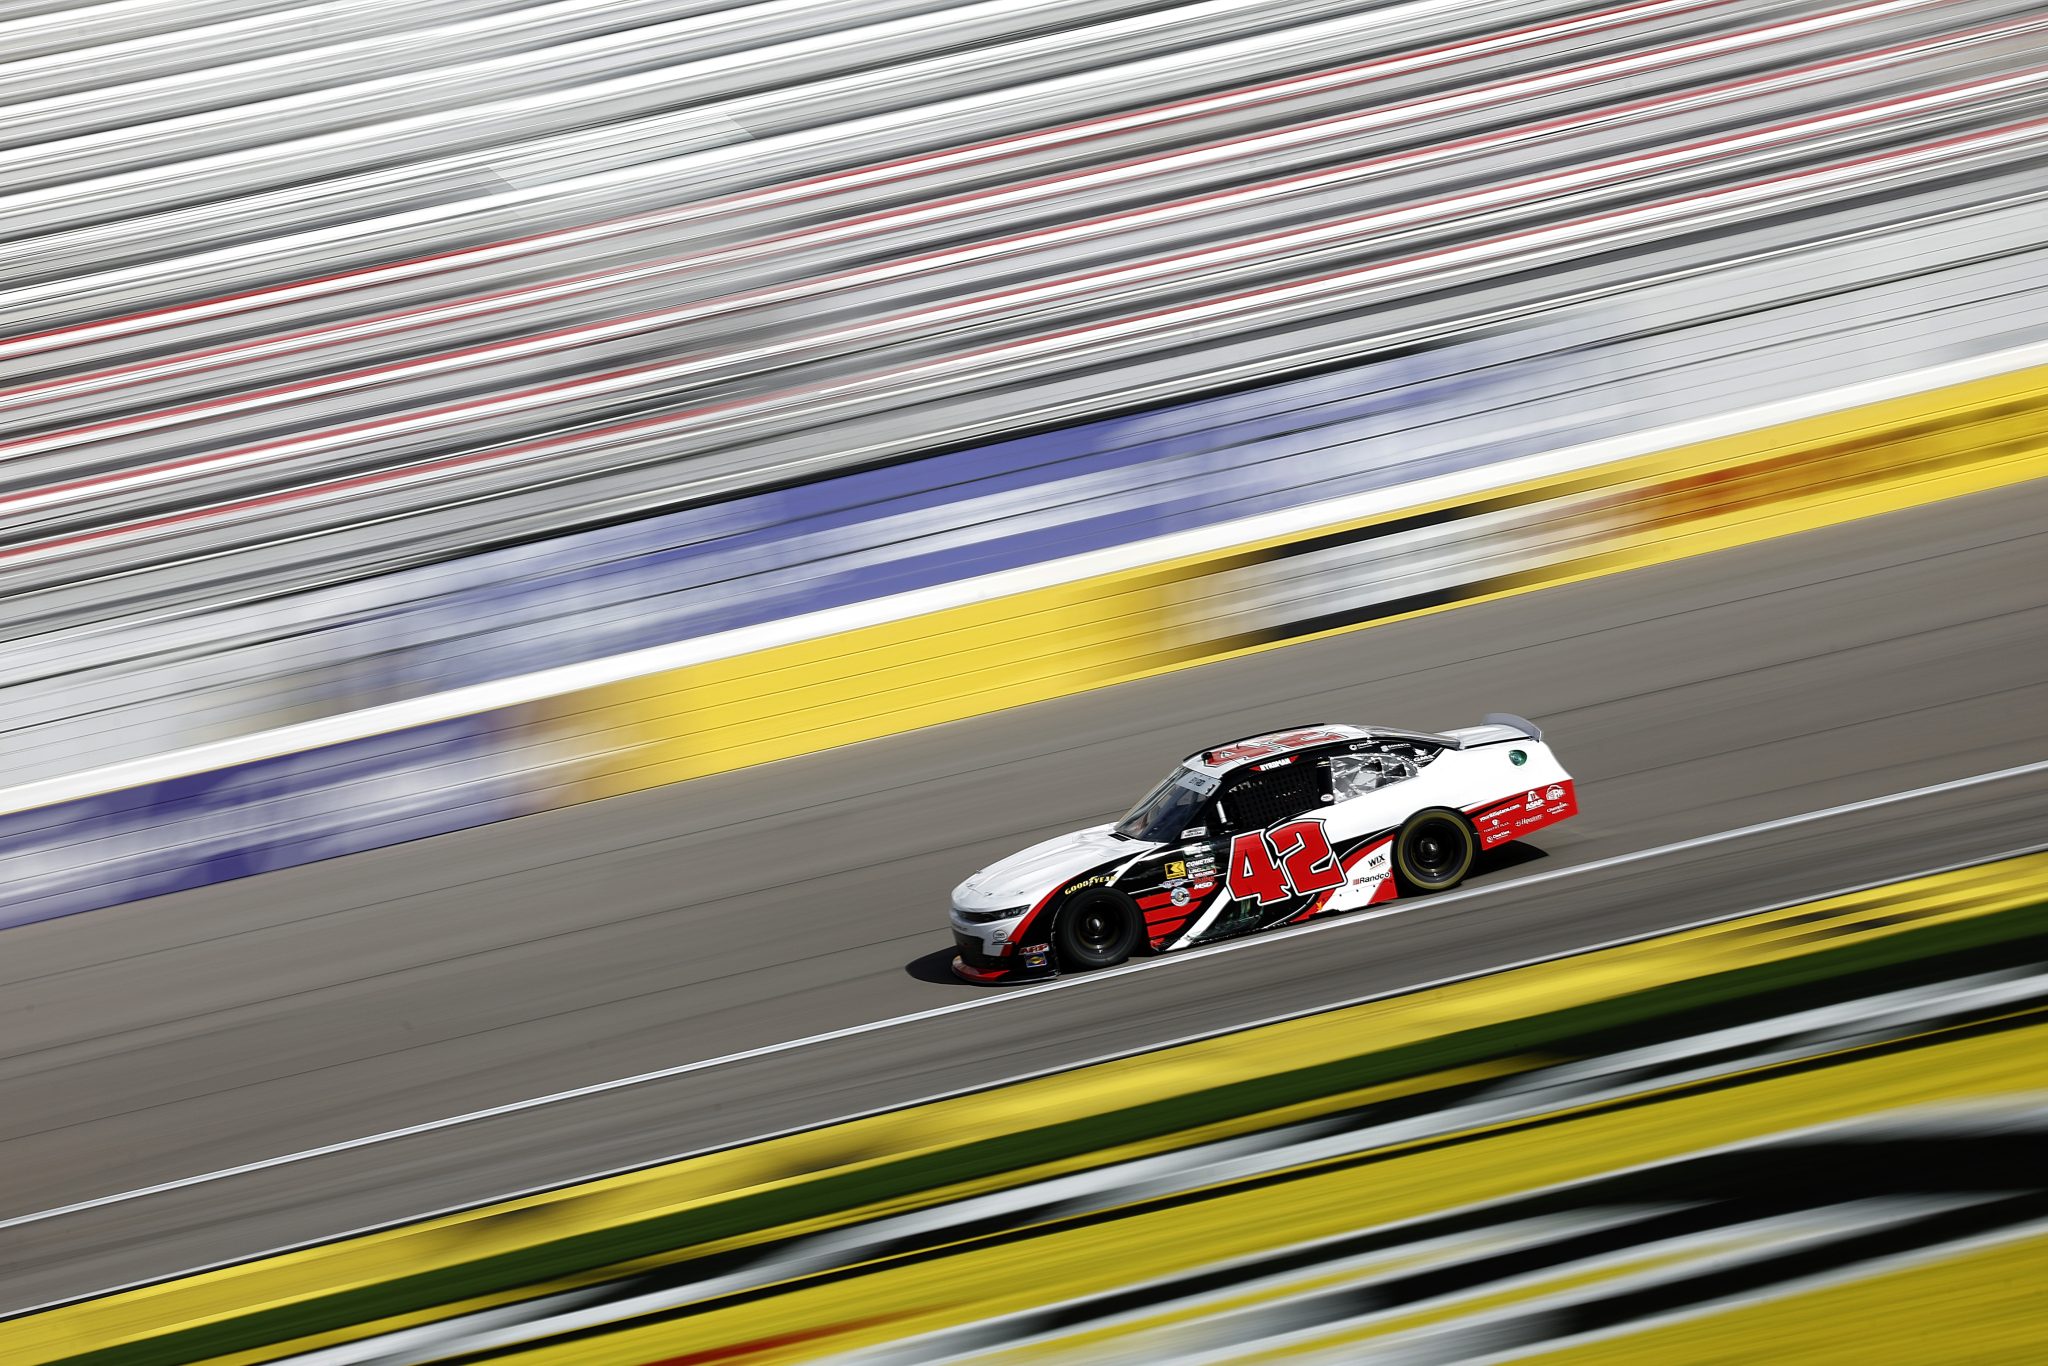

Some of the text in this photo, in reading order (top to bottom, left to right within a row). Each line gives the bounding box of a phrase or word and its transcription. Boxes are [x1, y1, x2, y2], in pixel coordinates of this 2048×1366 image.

[1226, 818, 1348, 906] 42
[1368, 854, 1386, 867] WIX
[1064, 875, 1117, 895] GOODYEAR
[1360, 872, 1390, 884] Randco
